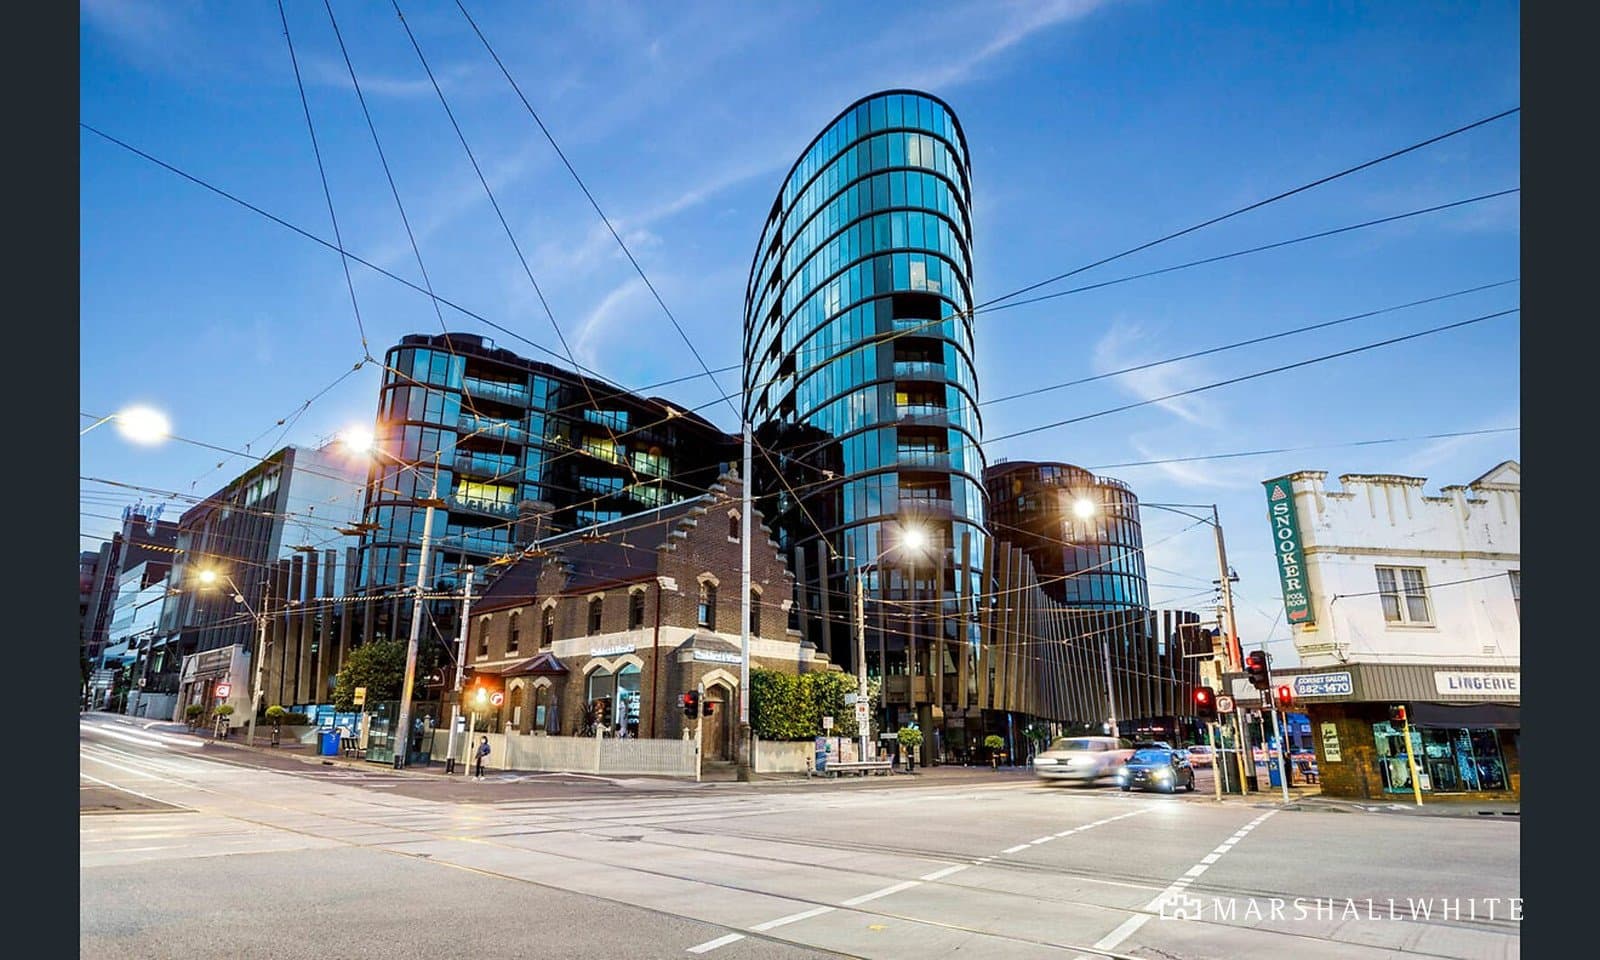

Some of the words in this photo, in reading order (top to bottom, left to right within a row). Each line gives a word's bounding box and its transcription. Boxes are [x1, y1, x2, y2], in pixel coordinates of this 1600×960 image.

[1273, 502, 1302, 592] SNOOKER
[1299, 683, 1349, 694] 882-1470
[1448, 677, 1517, 690] LINGERIE
